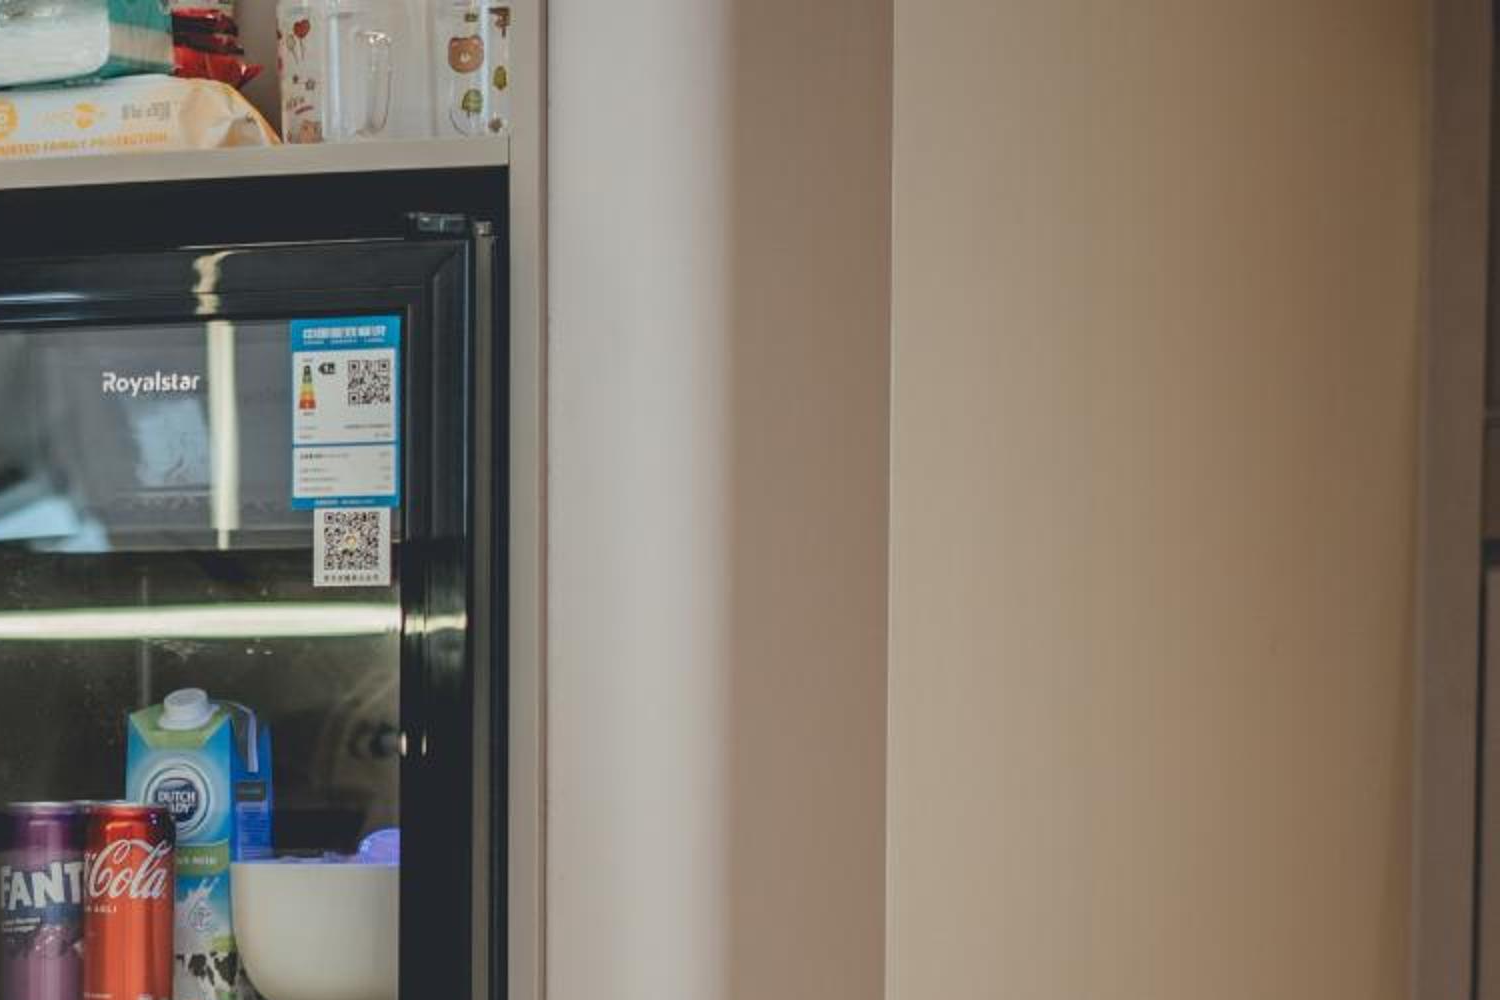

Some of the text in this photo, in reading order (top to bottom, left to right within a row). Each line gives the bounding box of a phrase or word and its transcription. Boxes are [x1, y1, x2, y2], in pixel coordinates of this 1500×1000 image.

[102, 371, 199, 397] Royalstar
[1, 861, 84, 910] FANT
[86, 839, 172, 899] Cola
